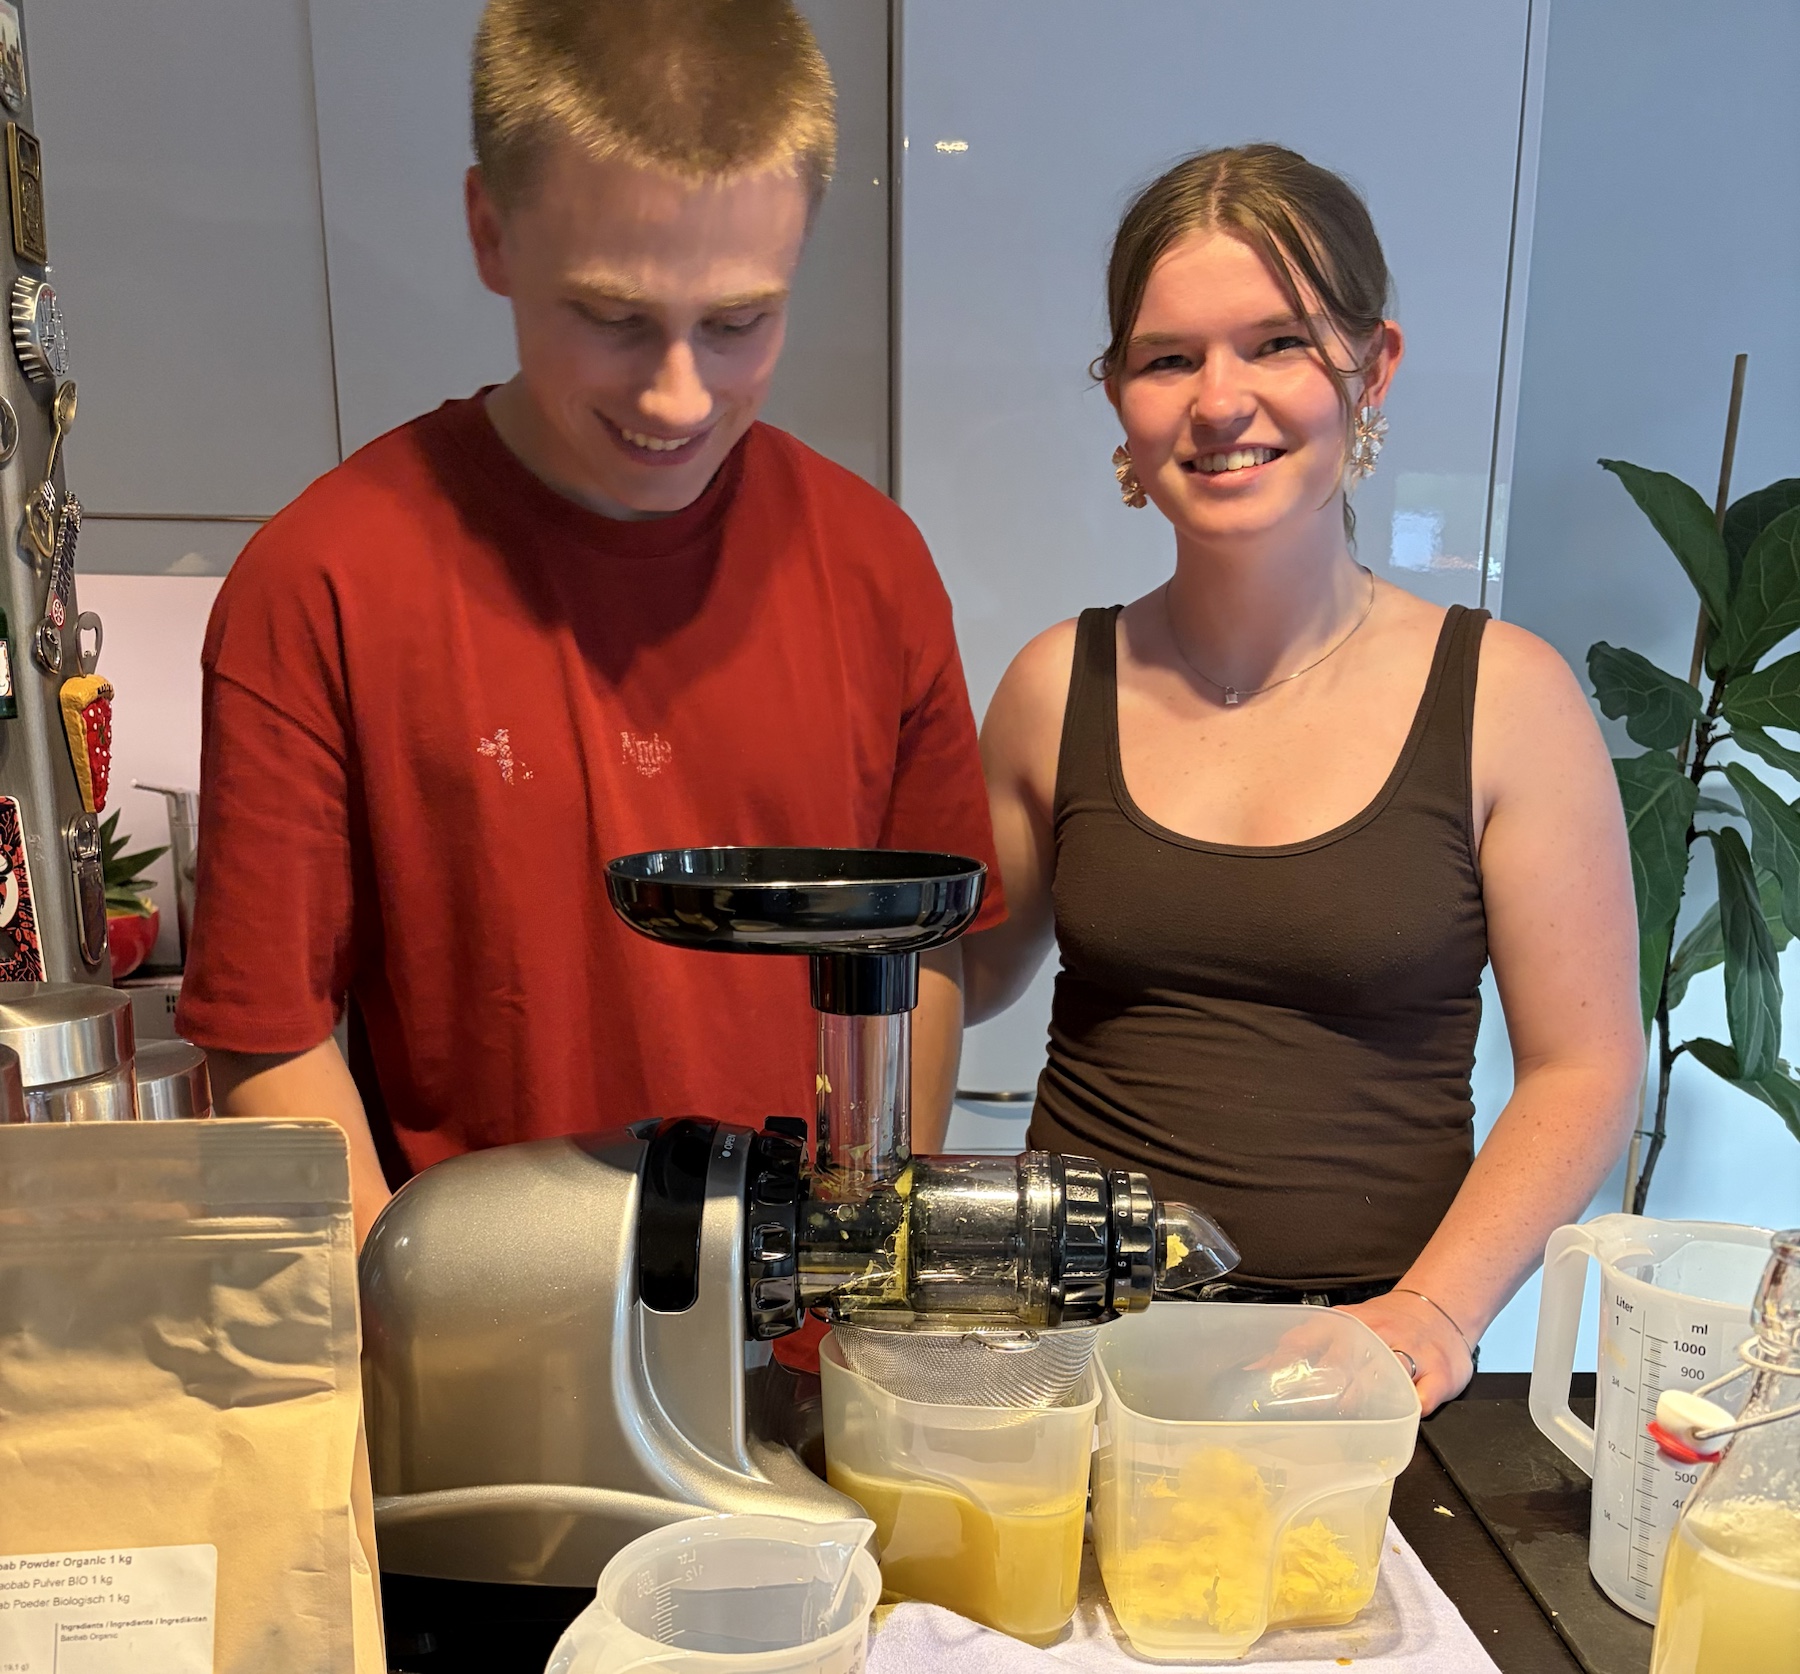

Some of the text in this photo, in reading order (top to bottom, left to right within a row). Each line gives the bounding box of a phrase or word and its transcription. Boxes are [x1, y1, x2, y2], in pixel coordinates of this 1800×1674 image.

[1616, 1295, 1634, 1313] Liter
[1615, 1315, 1620, 1326] 1
[1691, 1324, 1708, 1335] ml
[1673, 1340, 1707, 1356] 1.000
[1681, 1366, 1705, 1381] 900
[1674, 1471, 1698, 1485] 500
[19, 1559, 60, 1570] Powder
[63, 1556, 106, 1568] Organic
[110, 1555, 115, 1564] 1
[118, 1554, 132, 1565] kg
[33, 1579, 65, 1588] Pulver
[68, 1576, 88, 1586] BIO
[92, 1575, 97, 1584] 1
[100, 1575, 113, 1585] kg
[13, 1598, 50, 1609] Poeder
[53, 1595, 105, 1607] Biologisch
[109, 1594, 114, 1603] 1
[117, 1594, 130, 1605] kg
[61, 1622, 104, 1632] Ingredients
[110, 1618, 153, 1629] Ingredients
[90, 1632, 118, 1641] Organic
